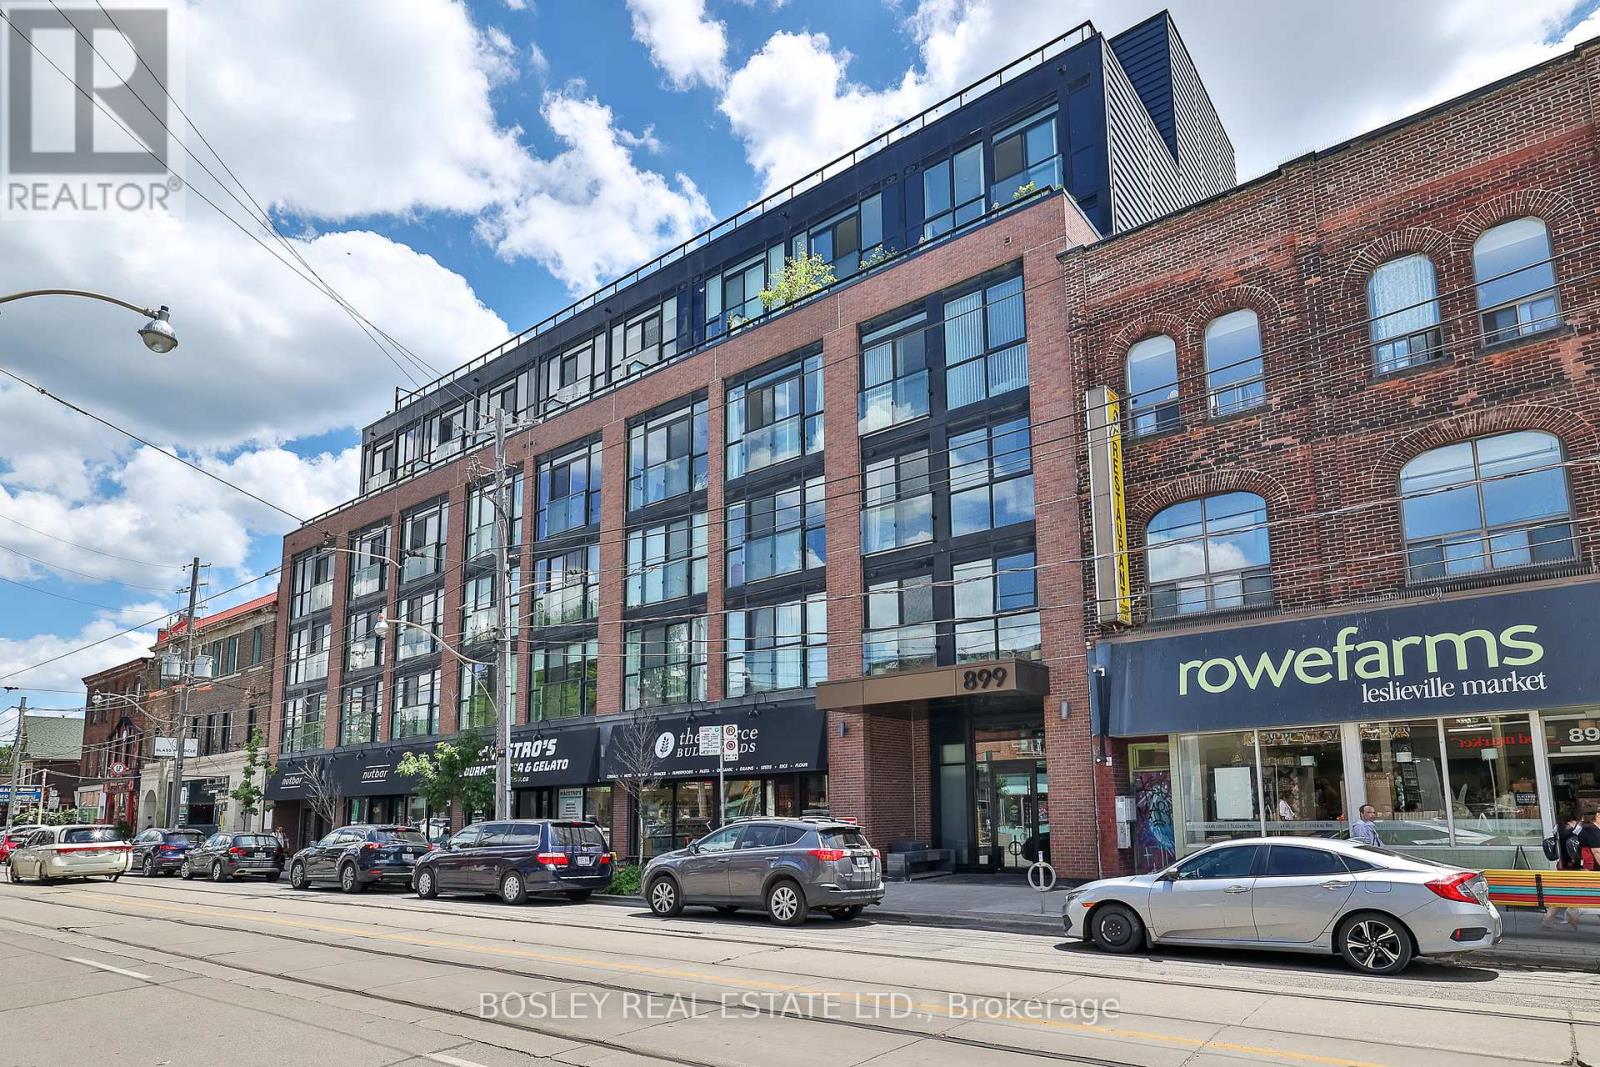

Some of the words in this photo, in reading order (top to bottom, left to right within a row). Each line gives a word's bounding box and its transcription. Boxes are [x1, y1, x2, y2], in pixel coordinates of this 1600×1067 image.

[963, 667, 1008, 690] 899
[1362, 677, 1456, 703] leslieville
[1462, 670, 1548, 696] market
[679, 727, 700, 745] the
[676, 747, 700, 757] BUL
[362, 769, 388, 779] nutbar
[459, 765, 497, 778] OURM
[533, 759, 569, 772] GELATO
[282, 777, 302, 785] nutbar
